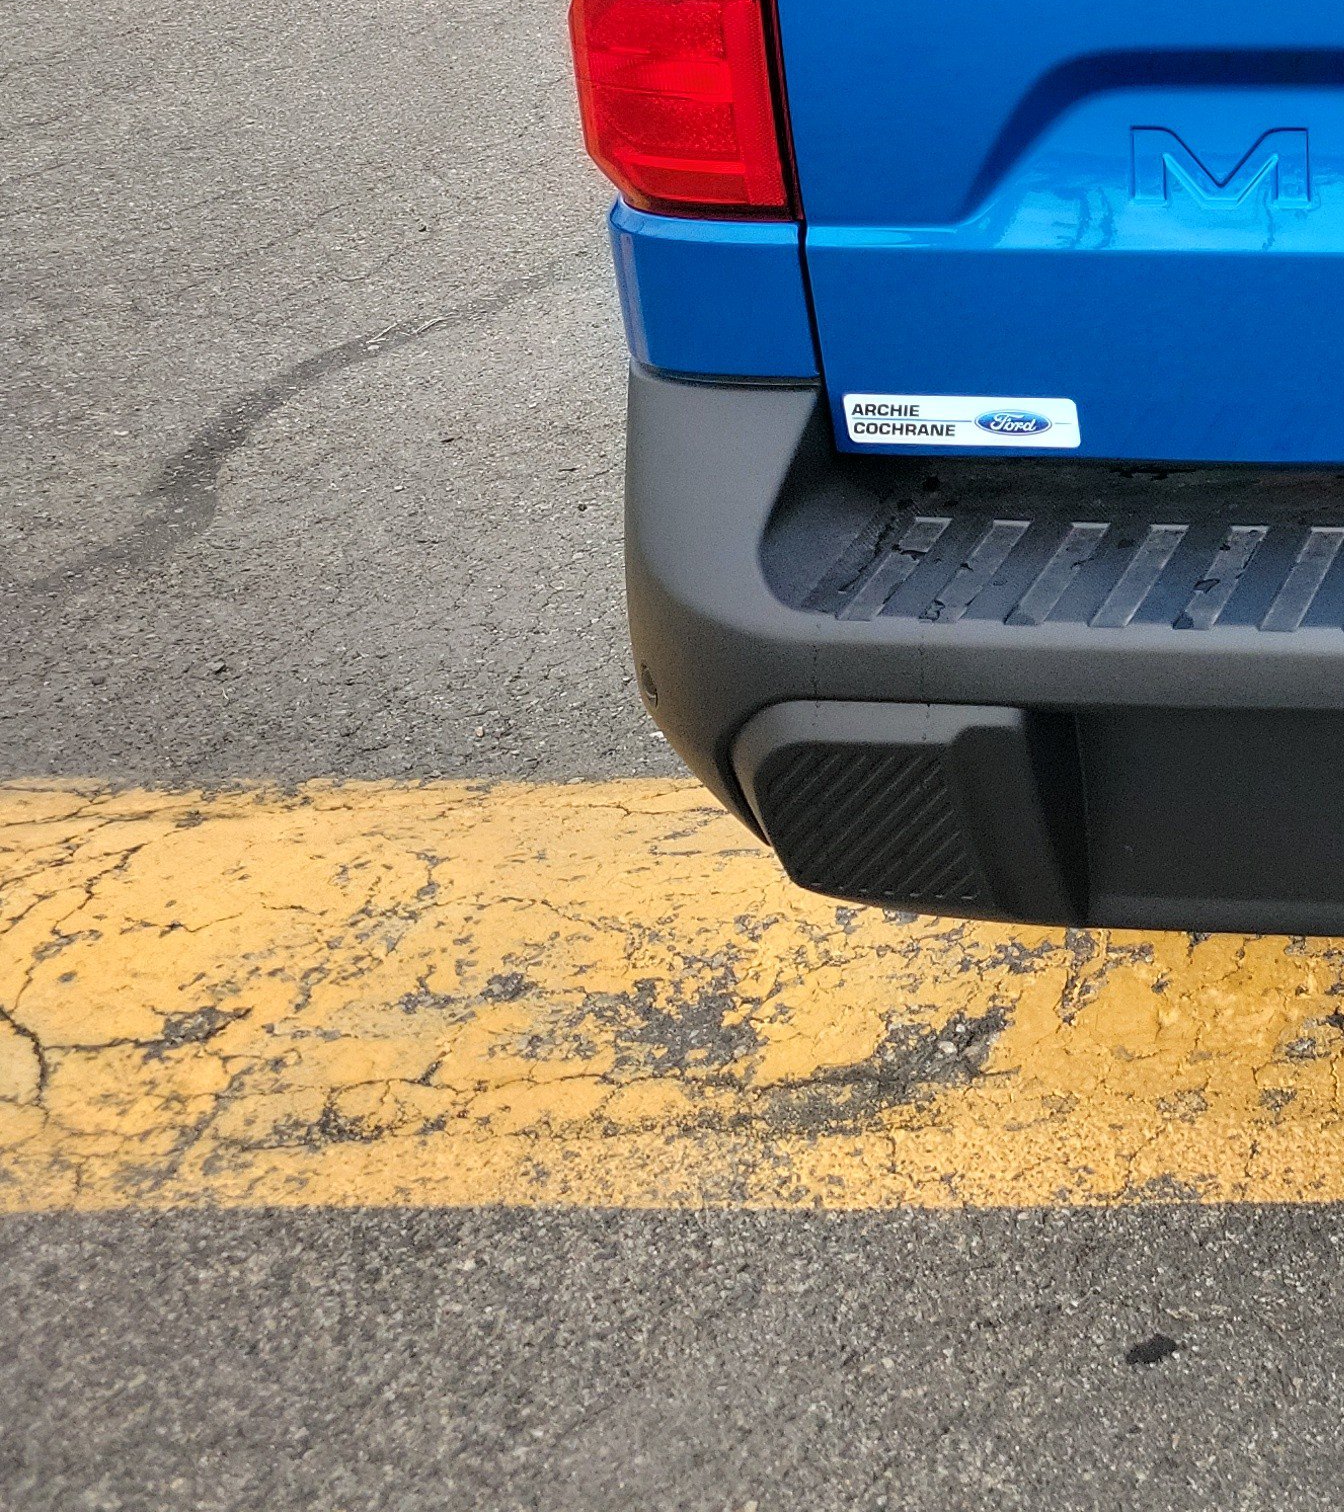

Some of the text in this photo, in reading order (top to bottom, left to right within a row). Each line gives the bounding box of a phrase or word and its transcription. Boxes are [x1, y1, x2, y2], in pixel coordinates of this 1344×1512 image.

[851, 403, 920, 417] ARCHIE
[853, 412, 1038, 437] COCHRANE Ford
